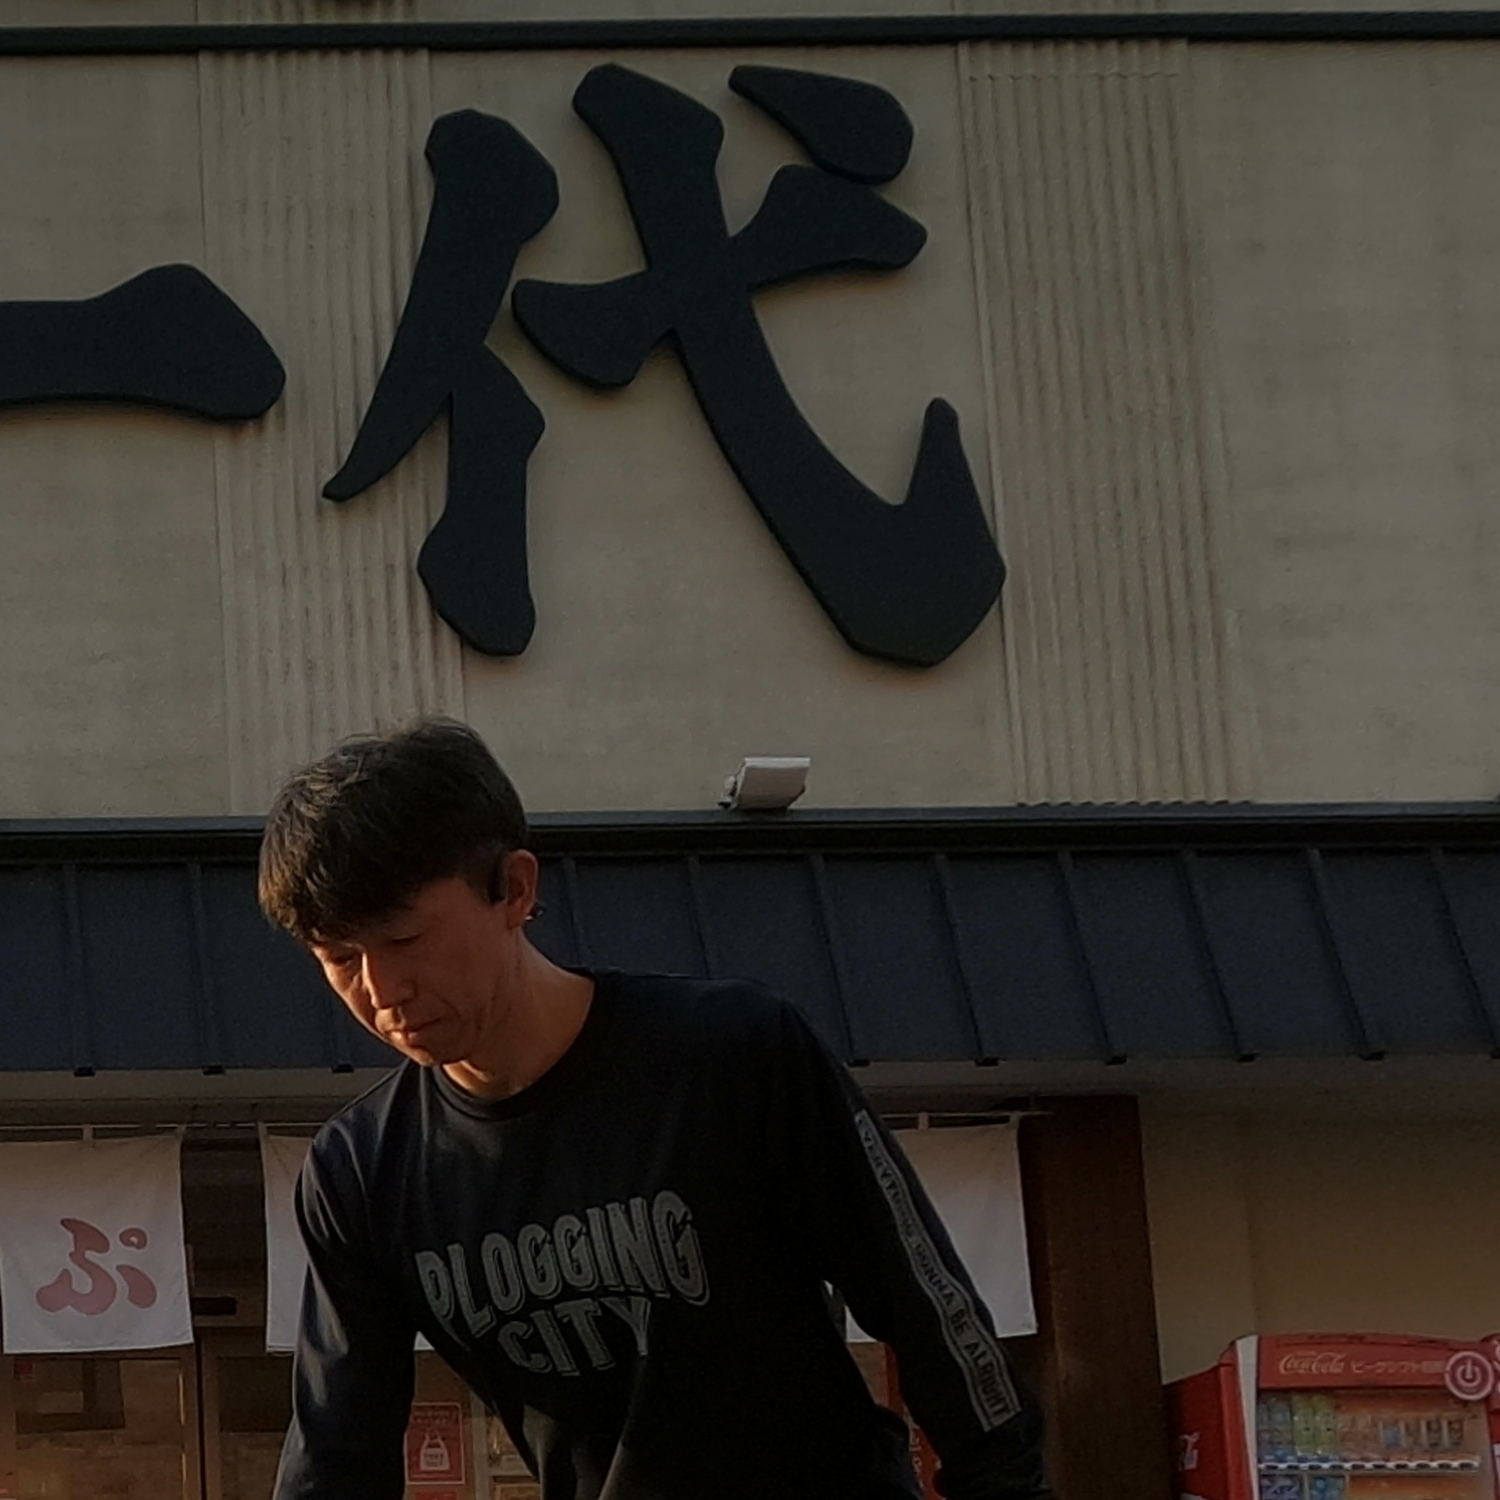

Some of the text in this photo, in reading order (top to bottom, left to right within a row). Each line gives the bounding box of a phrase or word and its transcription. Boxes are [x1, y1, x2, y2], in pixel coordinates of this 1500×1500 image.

[414, 1190, 710, 1347] PLOGGING
[497, 1295, 652, 1377] CITY
[915, 1243, 955, 1305] GONNA
[949, 1307, 970, 1337] BE
[964, 1341, 1012, 1417] ALRIGHT
